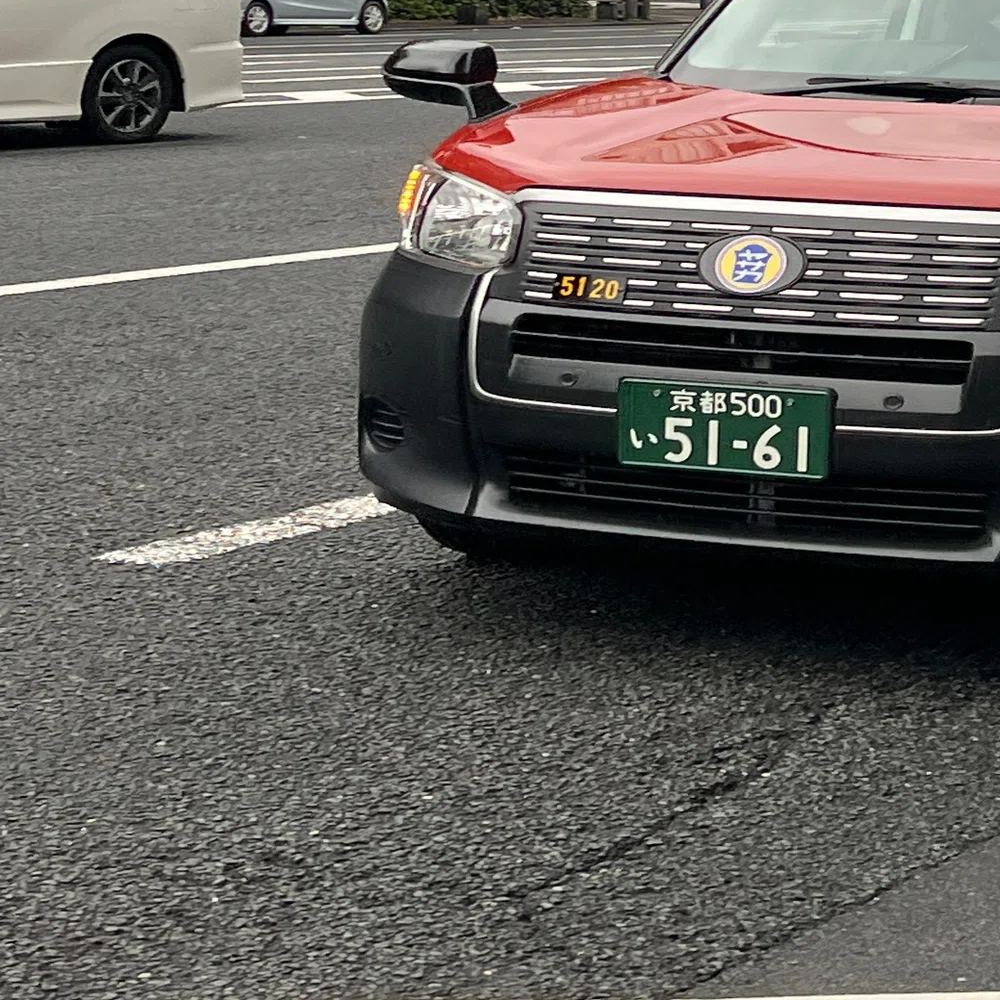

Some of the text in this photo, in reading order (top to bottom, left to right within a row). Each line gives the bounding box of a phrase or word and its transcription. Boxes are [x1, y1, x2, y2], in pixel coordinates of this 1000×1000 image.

[559, 275, 620, 300] 5120
[668, 388, 783, 419] 京都500
[629, 416, 810, 473] い 51-61
